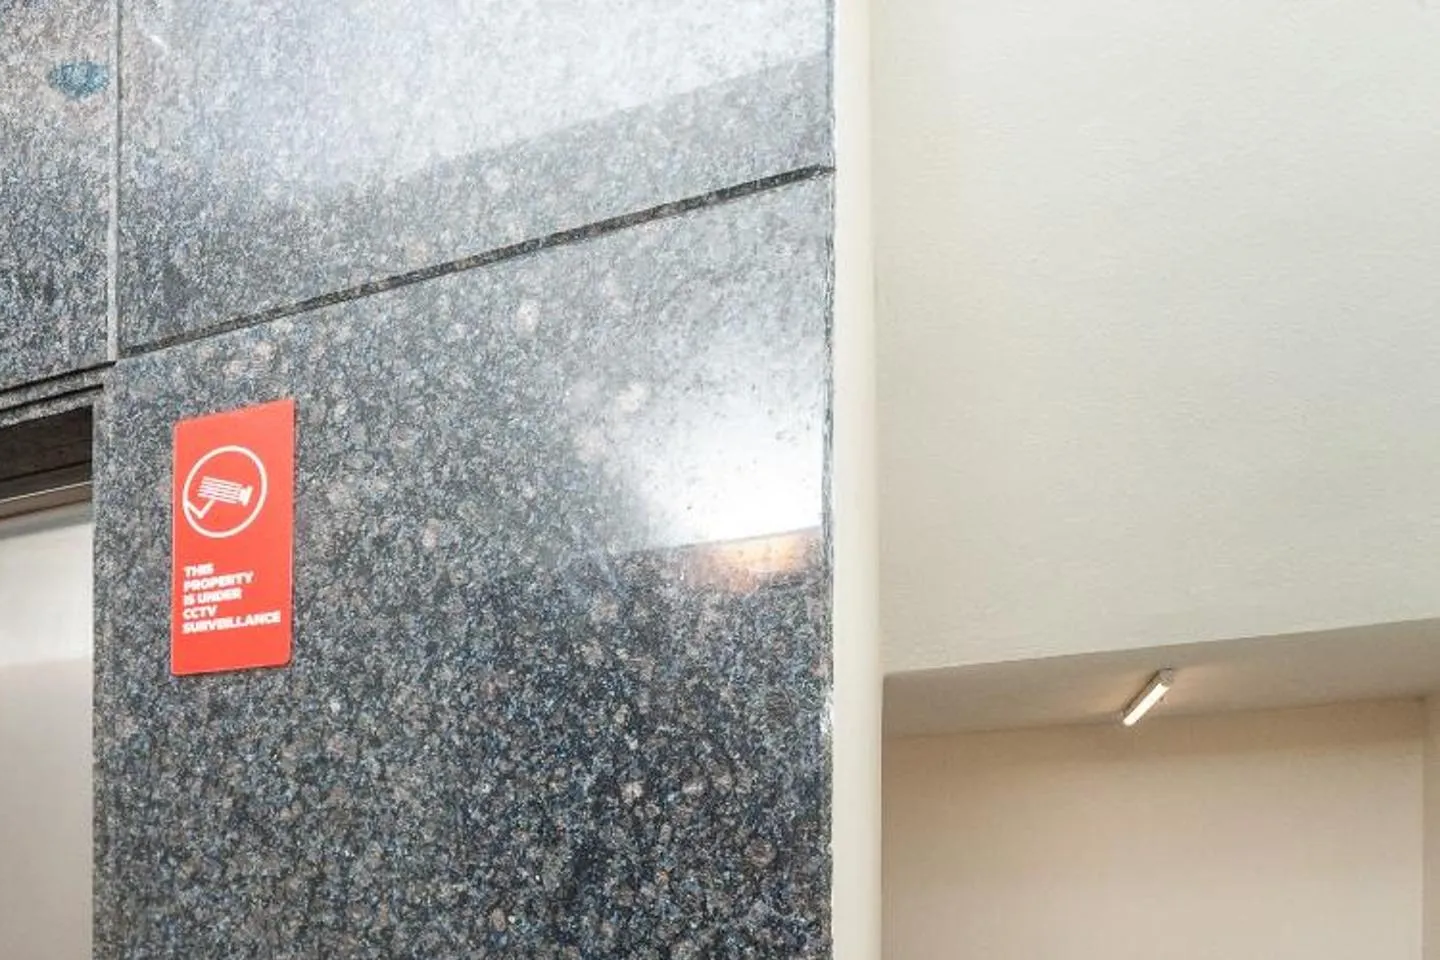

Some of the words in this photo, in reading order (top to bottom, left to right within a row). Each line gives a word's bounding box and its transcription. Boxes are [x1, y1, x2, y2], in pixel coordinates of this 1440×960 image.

[184, 563, 215, 577] THIS
[183, 571, 254, 591] PROPERTY
[183, 594, 195, 606] IS
[197, 588, 242, 604] UNDER
[182, 605, 217, 620] CCTV
[182, 611, 281, 635] SURVEILLANCE
